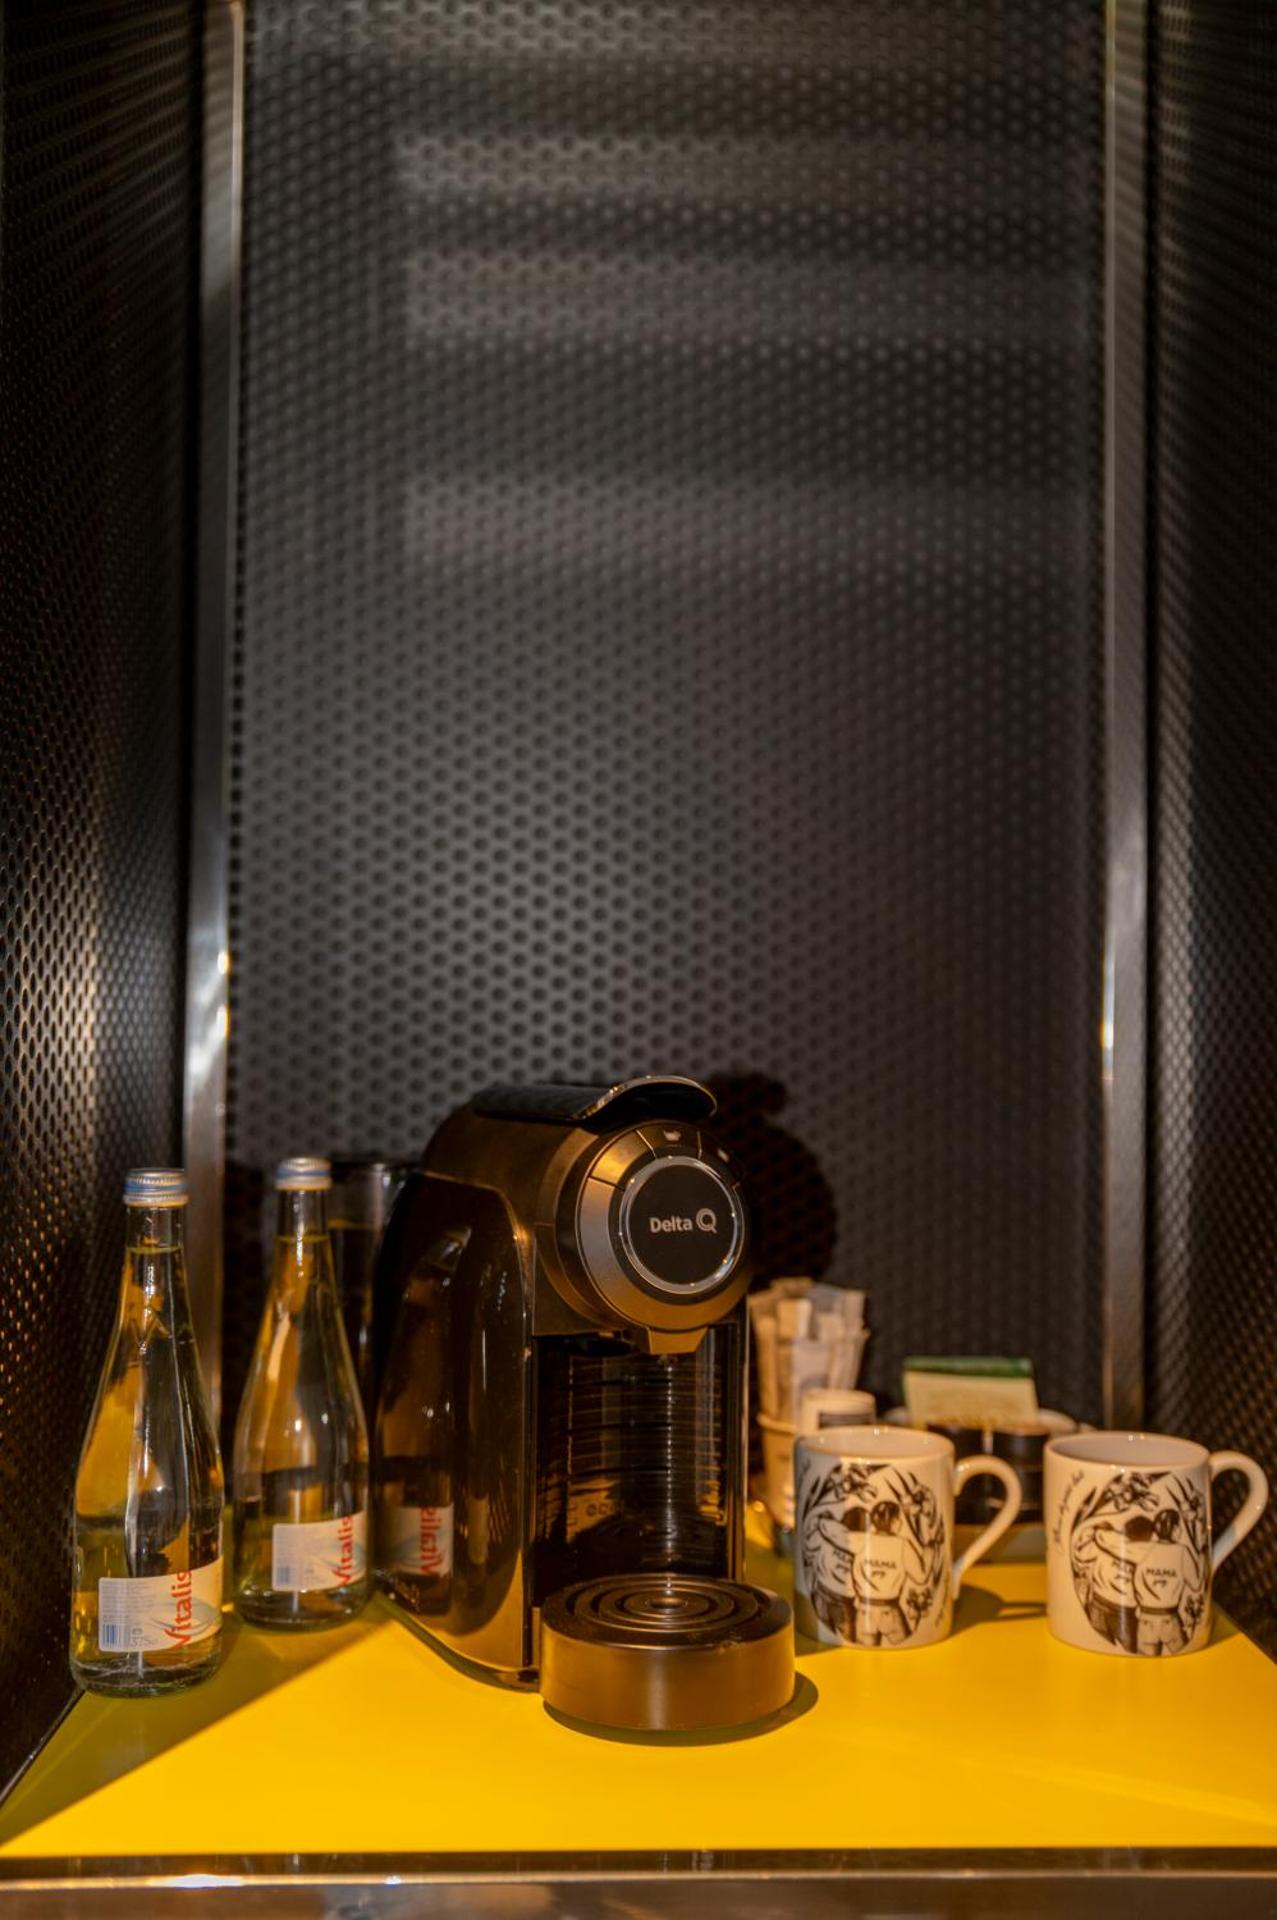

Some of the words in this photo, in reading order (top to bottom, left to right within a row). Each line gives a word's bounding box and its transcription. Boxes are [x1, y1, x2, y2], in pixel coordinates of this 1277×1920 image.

[649, 1216, 693, 1233] Delta
[696, 1208, 717, 1233] Q
[1147, 1566, 1178, 1577] MAMA
[164, 1569, 192, 1651] Vitalis
